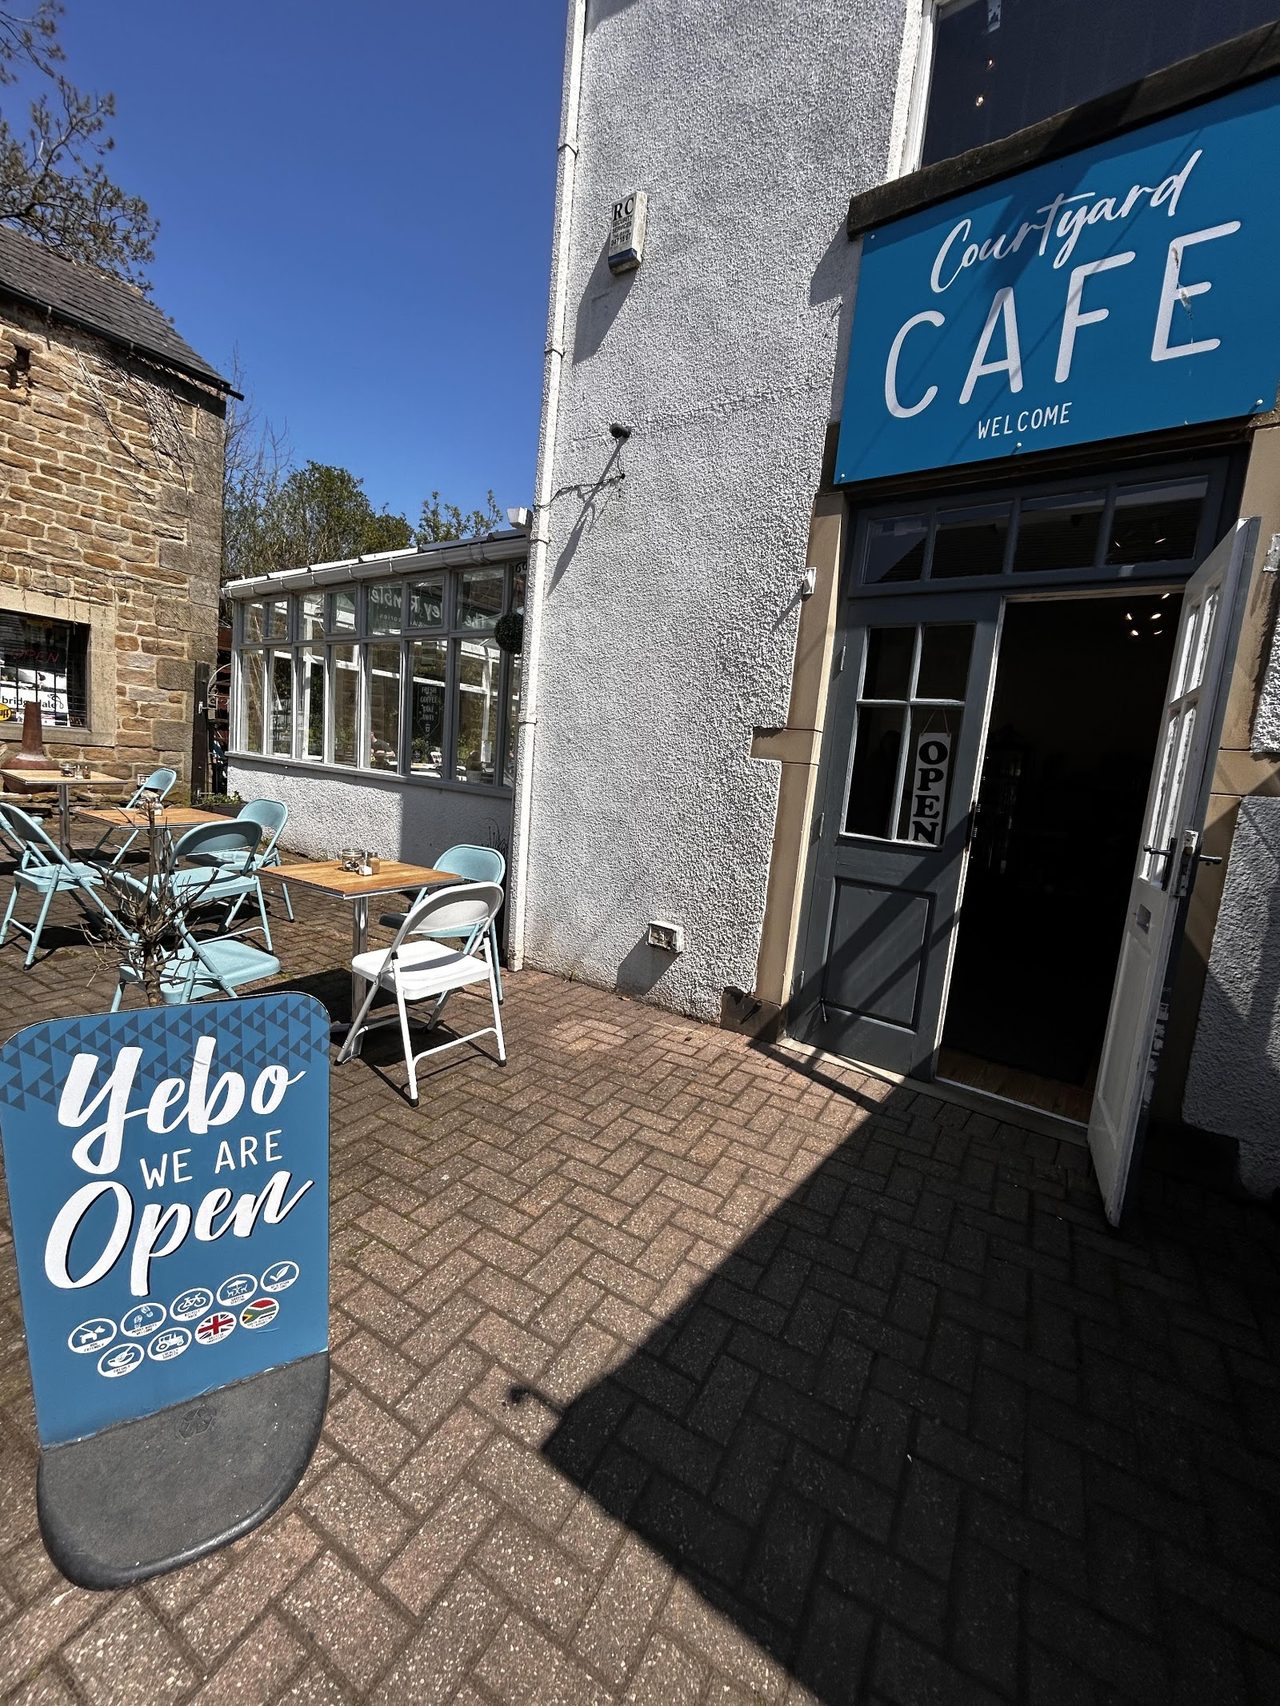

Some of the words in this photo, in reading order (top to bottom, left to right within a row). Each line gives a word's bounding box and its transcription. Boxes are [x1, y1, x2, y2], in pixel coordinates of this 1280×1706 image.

[930, 149, 1203, 293] Courtyard
[884, 220, 1241, 418] CAFE
[977, 402, 1073, 440] WELCOME
[912, 740, 949, 843] OPEN
[57, 1035, 307, 1174] Yebo
[139, 1148, 193, 1190] WE
[214, 1129, 283, 1174] ARE
[44, 1170, 315, 1297] Open
